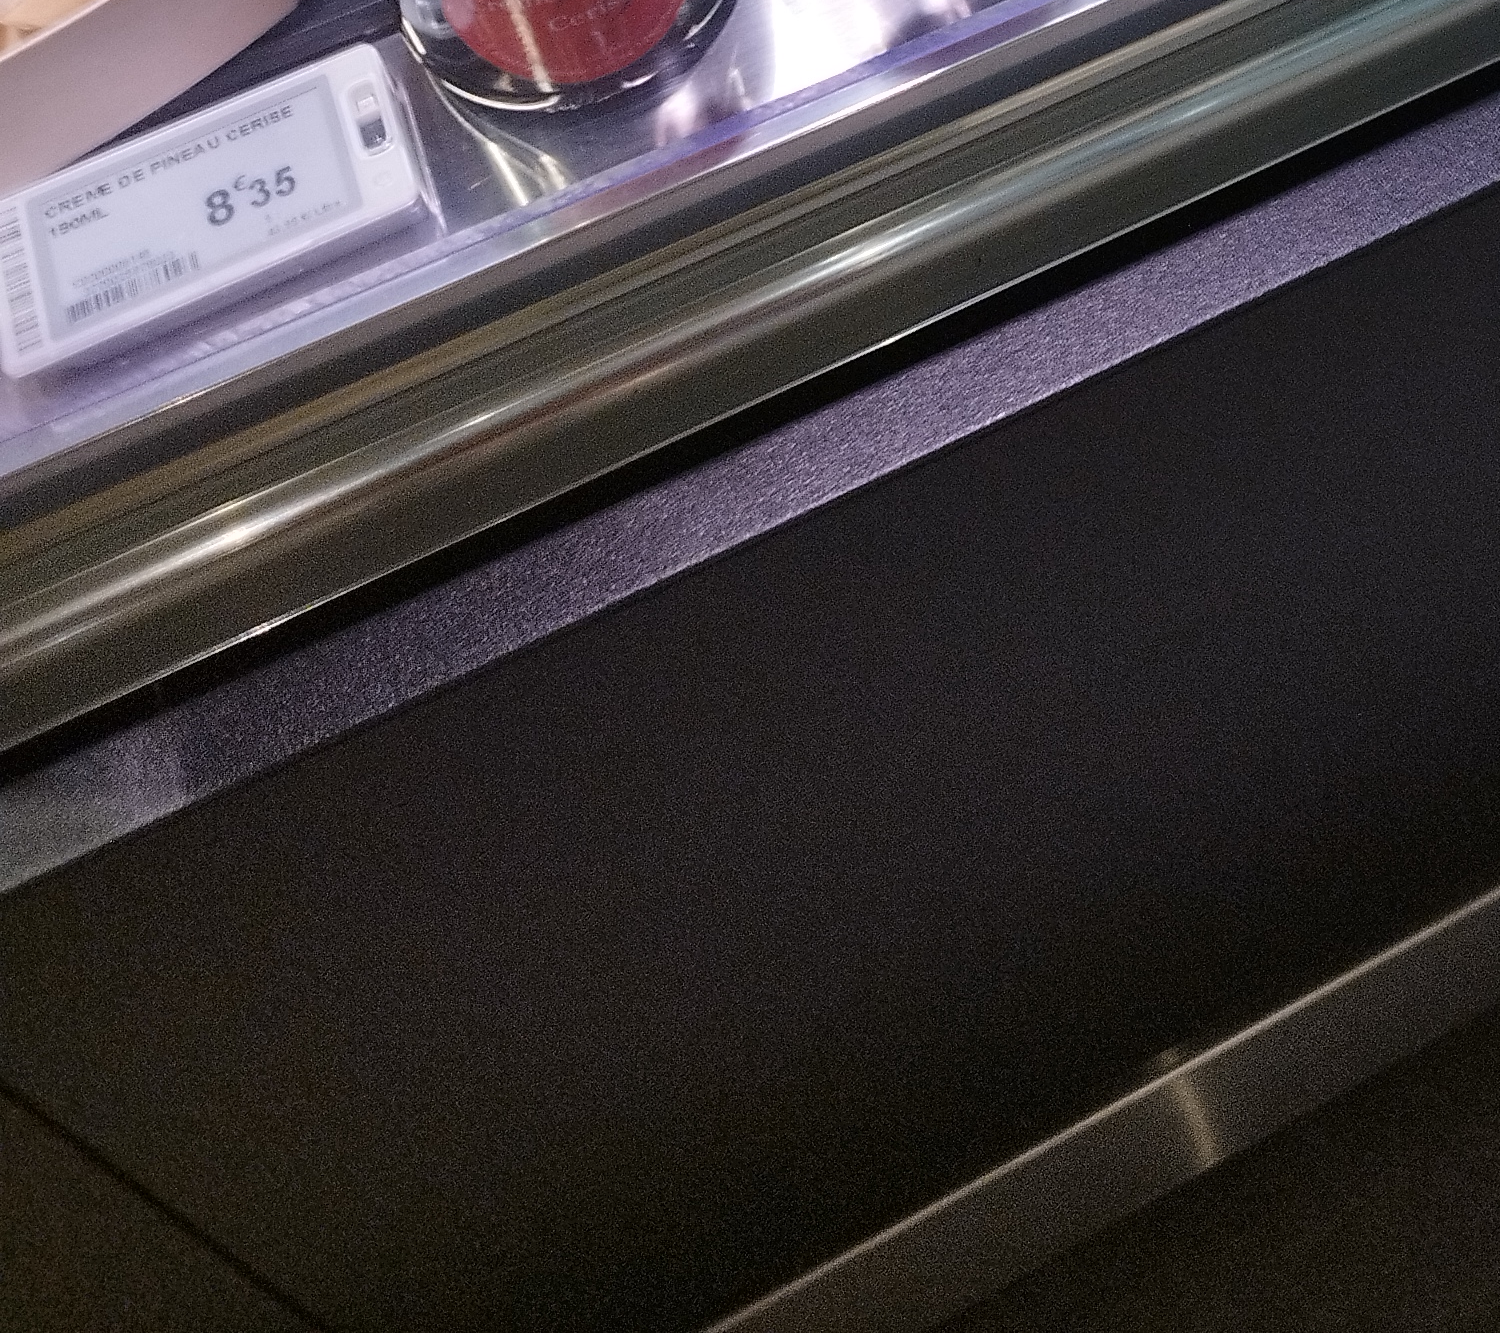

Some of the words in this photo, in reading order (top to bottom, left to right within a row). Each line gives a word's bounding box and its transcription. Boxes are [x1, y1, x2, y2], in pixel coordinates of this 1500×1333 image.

[43, 182, 114, 219] CREME
[117, 167, 147, 190] DE
[149, 135, 221, 176] PINEAU
